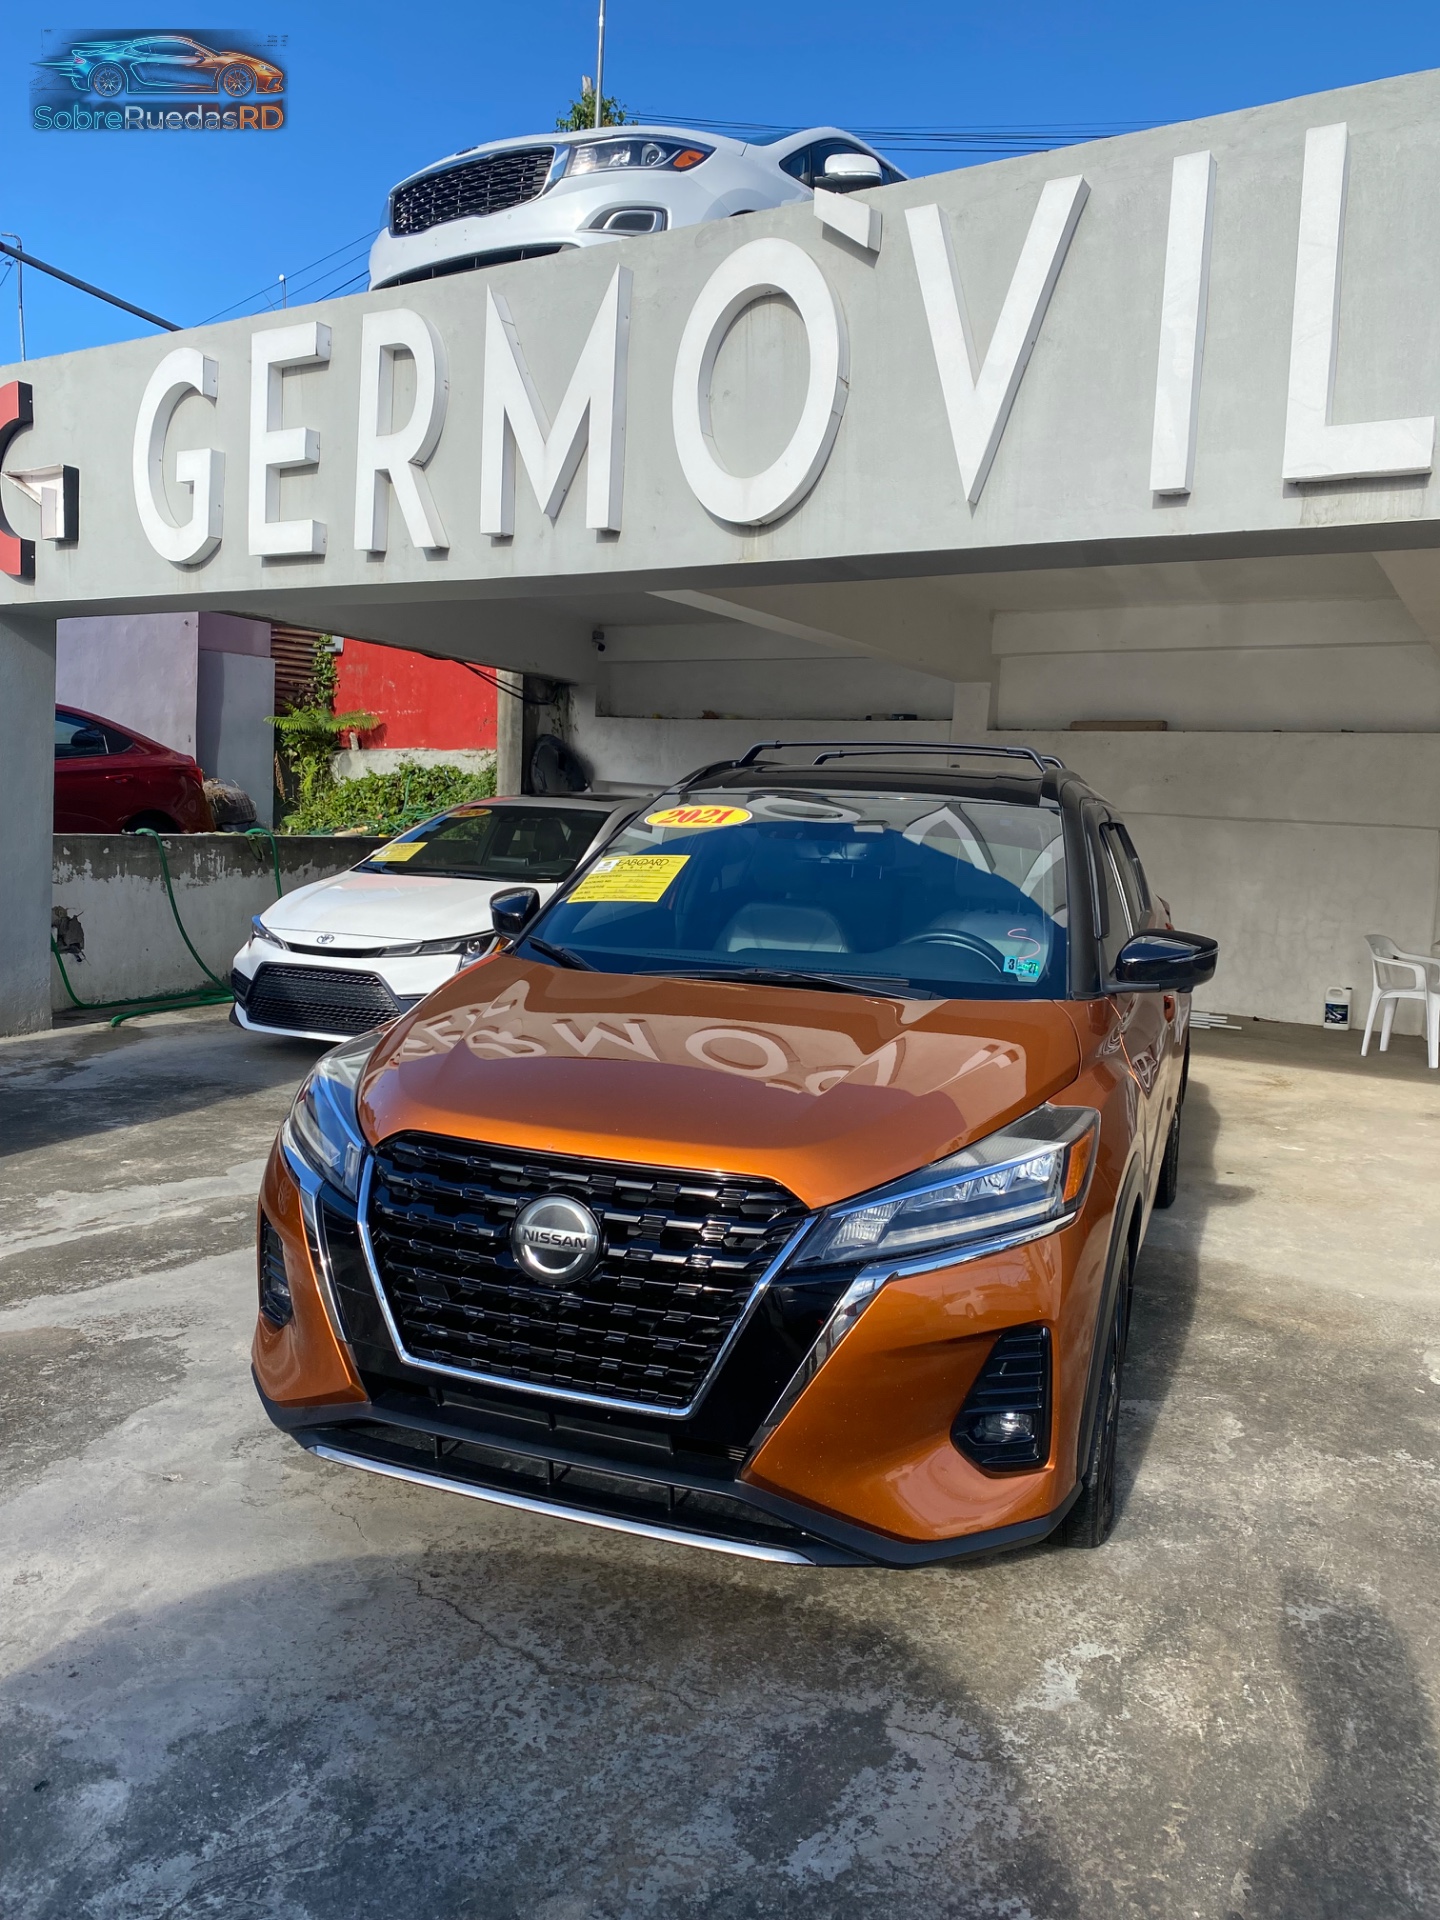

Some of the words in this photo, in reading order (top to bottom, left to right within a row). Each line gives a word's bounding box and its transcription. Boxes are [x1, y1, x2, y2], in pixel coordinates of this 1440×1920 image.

[657, 809, 735, 824] 2021
[615, 858, 670, 866] EABOARD
[523, 1229, 588, 1249] NISSAN
